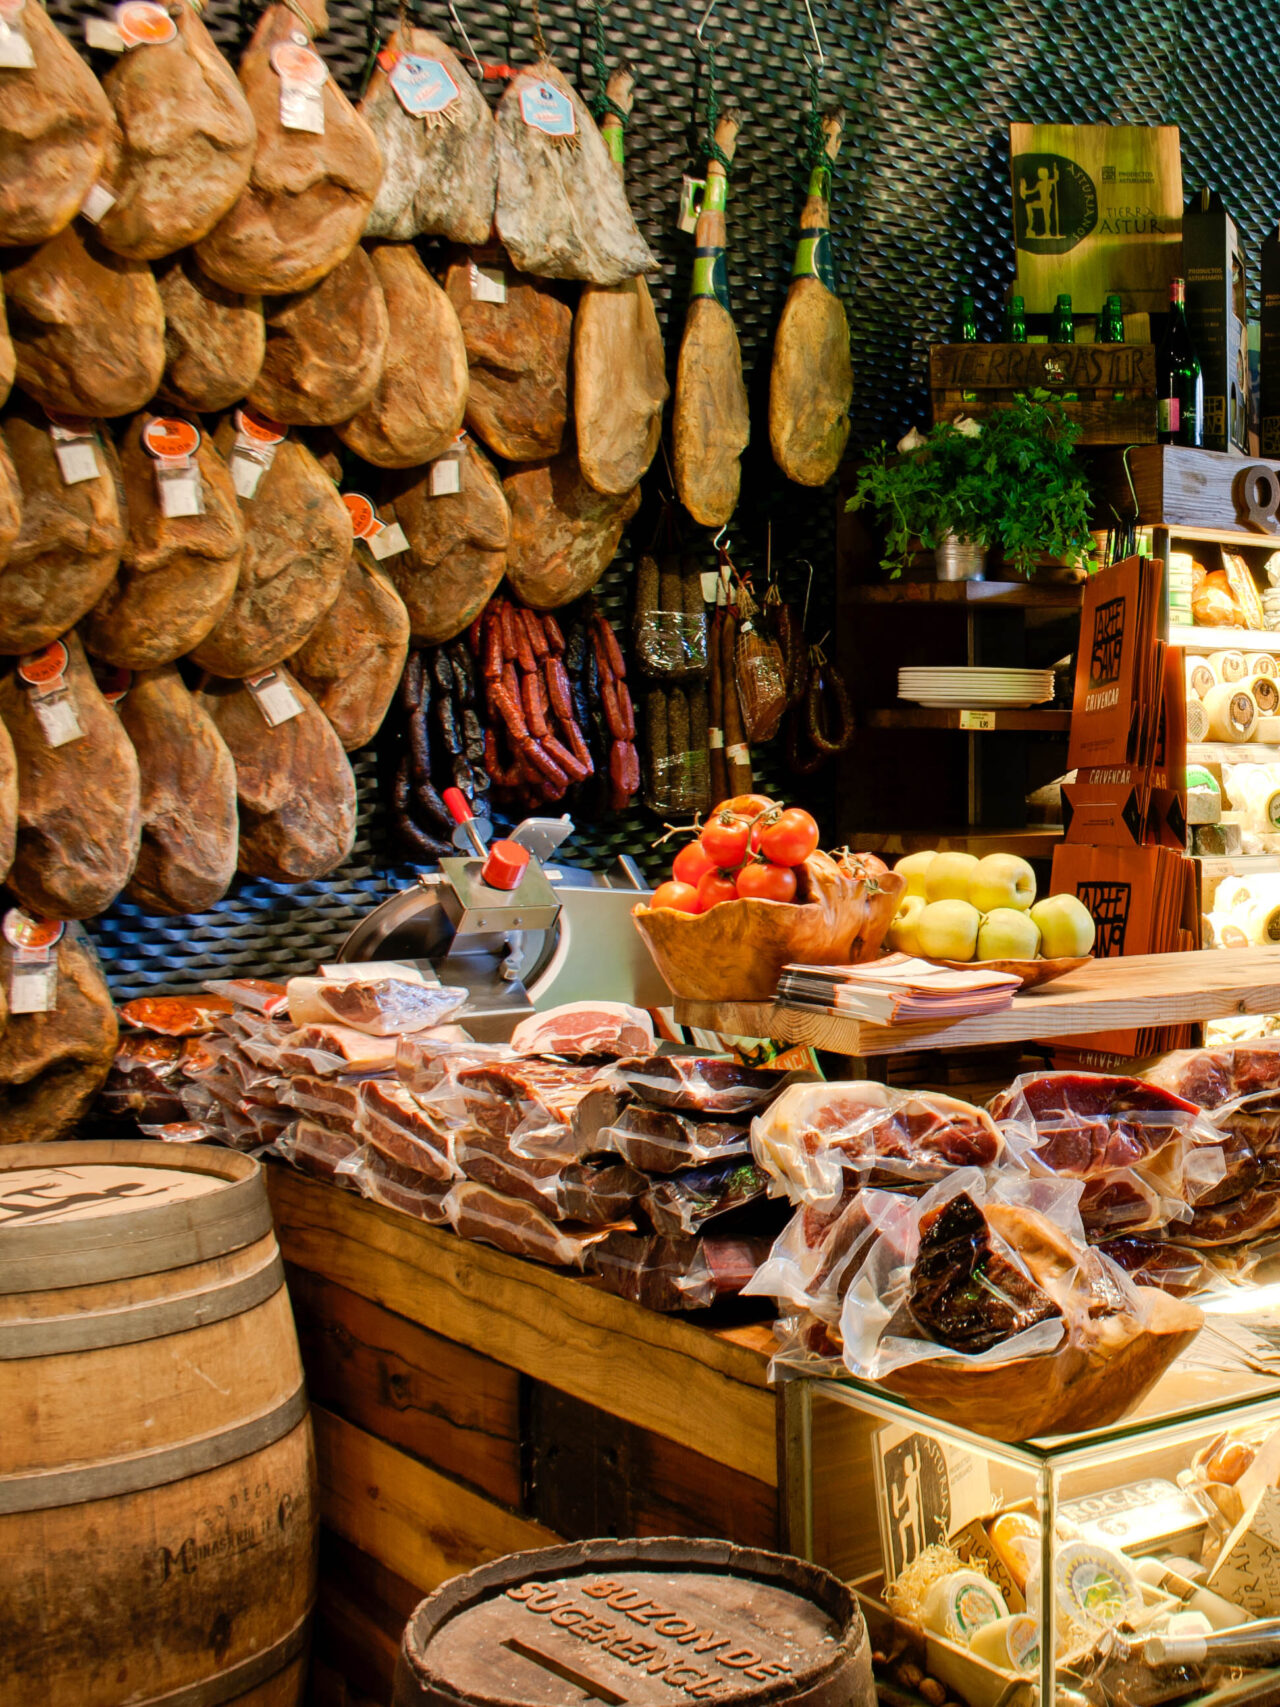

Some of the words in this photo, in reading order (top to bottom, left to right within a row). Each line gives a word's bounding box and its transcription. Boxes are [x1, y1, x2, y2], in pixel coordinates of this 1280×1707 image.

[1099, 219, 1165, 235] ASTUR
[1106, 207, 1156, 218] TIERRA
[1085, 688, 1119, 712] CRIVENCAR
[923, 1438, 951, 1546] ASTURIANO
[1060, 1483, 1156, 1523] ROCAS
[581, 1578, 731, 1653] BUZON
[715, 1648, 793, 1682] DE
